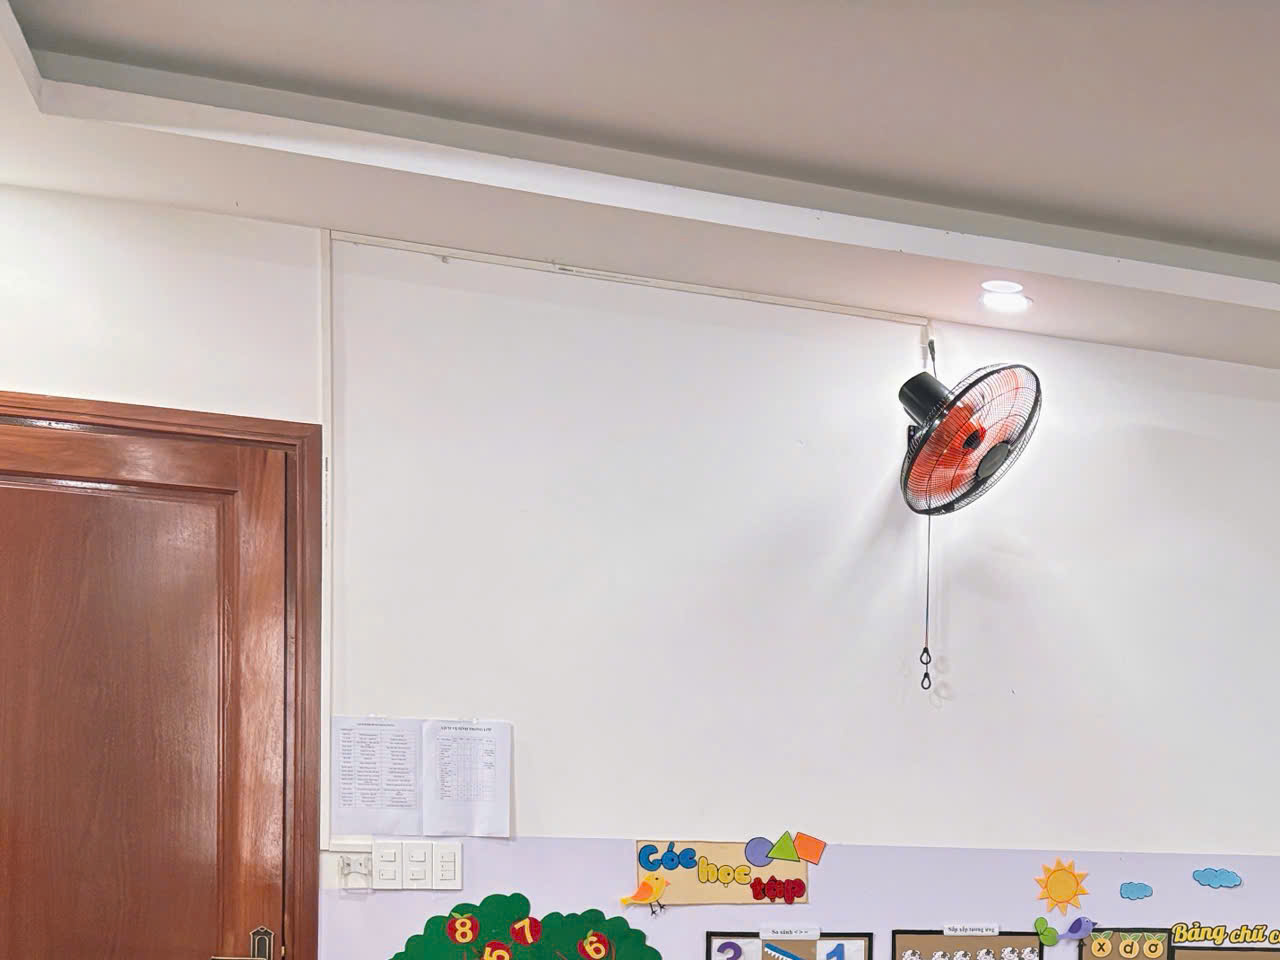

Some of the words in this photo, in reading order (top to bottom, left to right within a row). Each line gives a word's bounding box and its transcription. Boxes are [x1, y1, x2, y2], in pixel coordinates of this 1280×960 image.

[639, 841, 697, 871] Góc
[698, 856, 751, 887] học
[750, 875, 806, 904] tập
[455, 920, 473, 943] 8
[515, 919, 533, 944] 7
[1172, 921, 1228, 946] Bảng
[1229, 924, 1268, 944] chữ
[585, 937, 605, 959] 6
[1097, 942, 1106, 952] x
[1123, 942, 1134, 954] d
[1148, 942, 1159, 953] ơ
